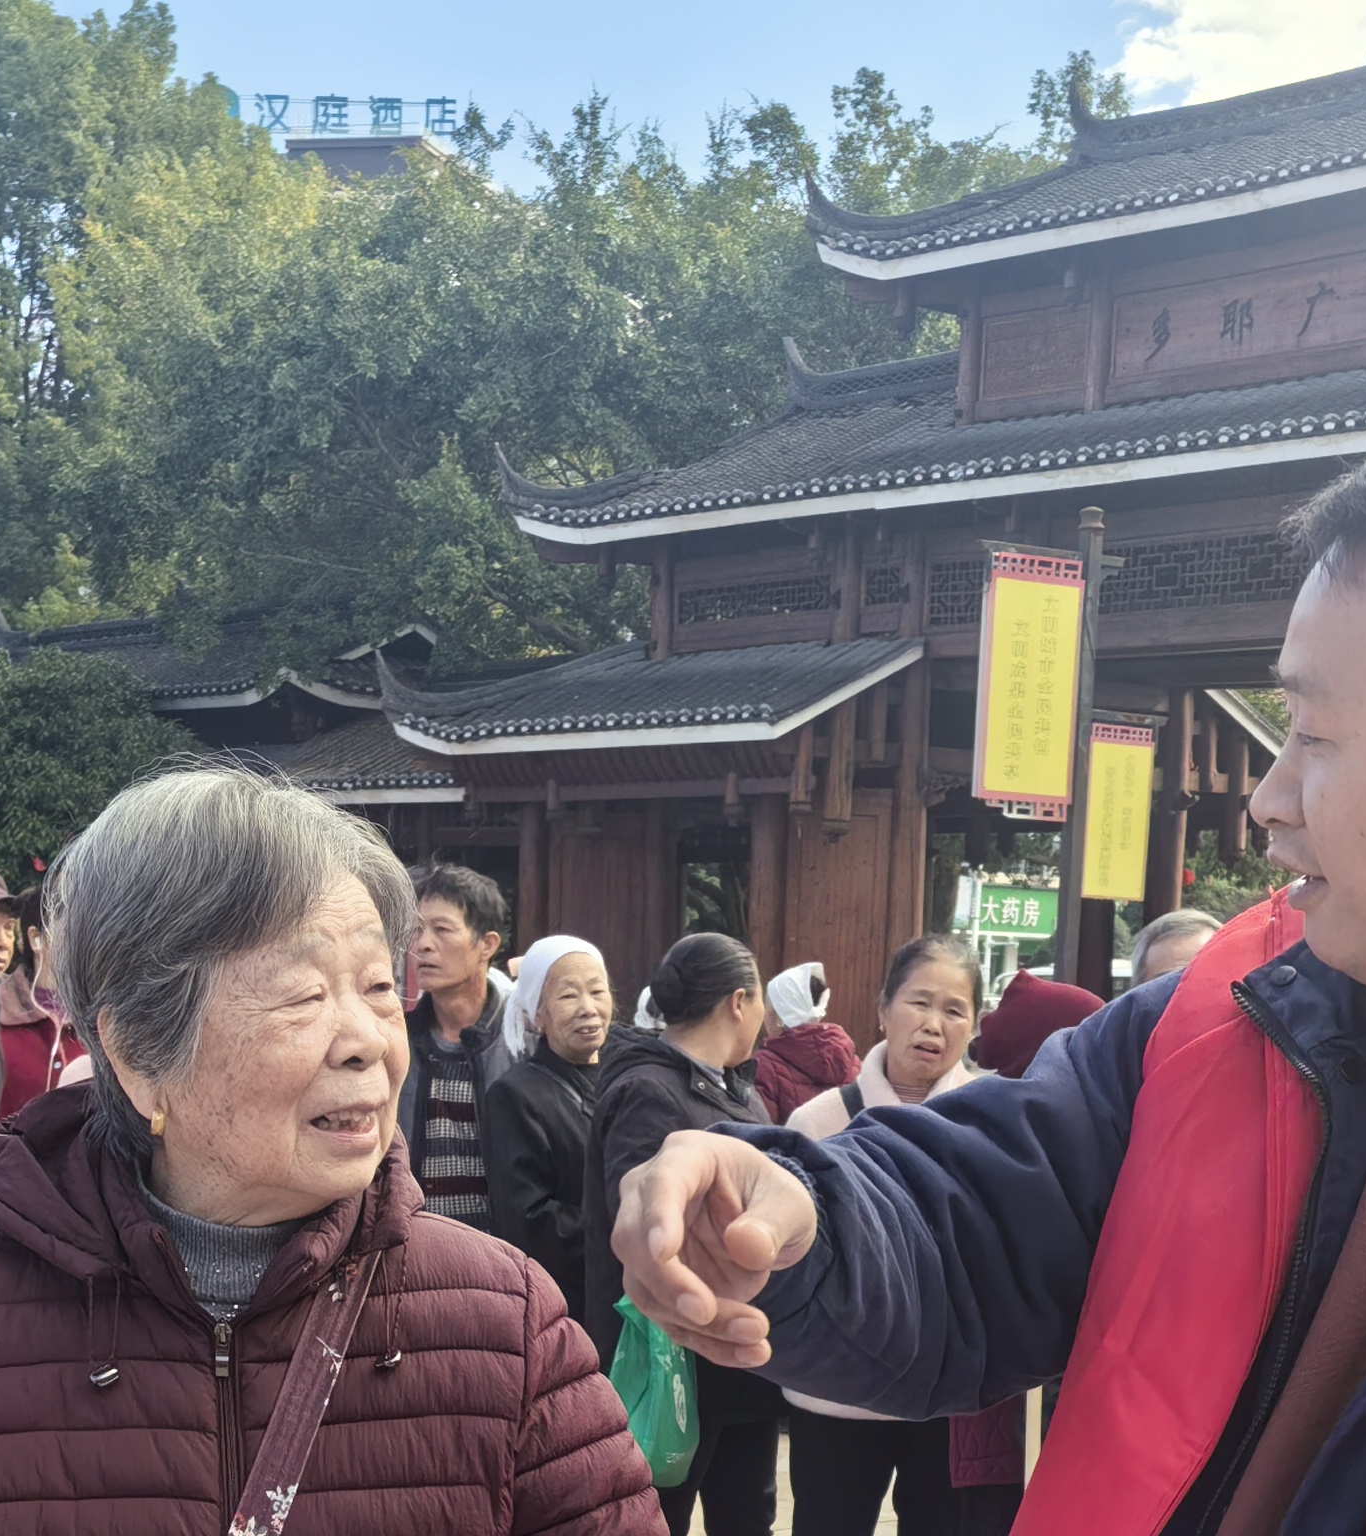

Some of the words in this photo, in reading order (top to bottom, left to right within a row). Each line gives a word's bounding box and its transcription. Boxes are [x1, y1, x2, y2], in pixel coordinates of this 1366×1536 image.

[254, 93, 456, 135] 汉庭酒店
[981, 896, 1040, 927] 大药房
